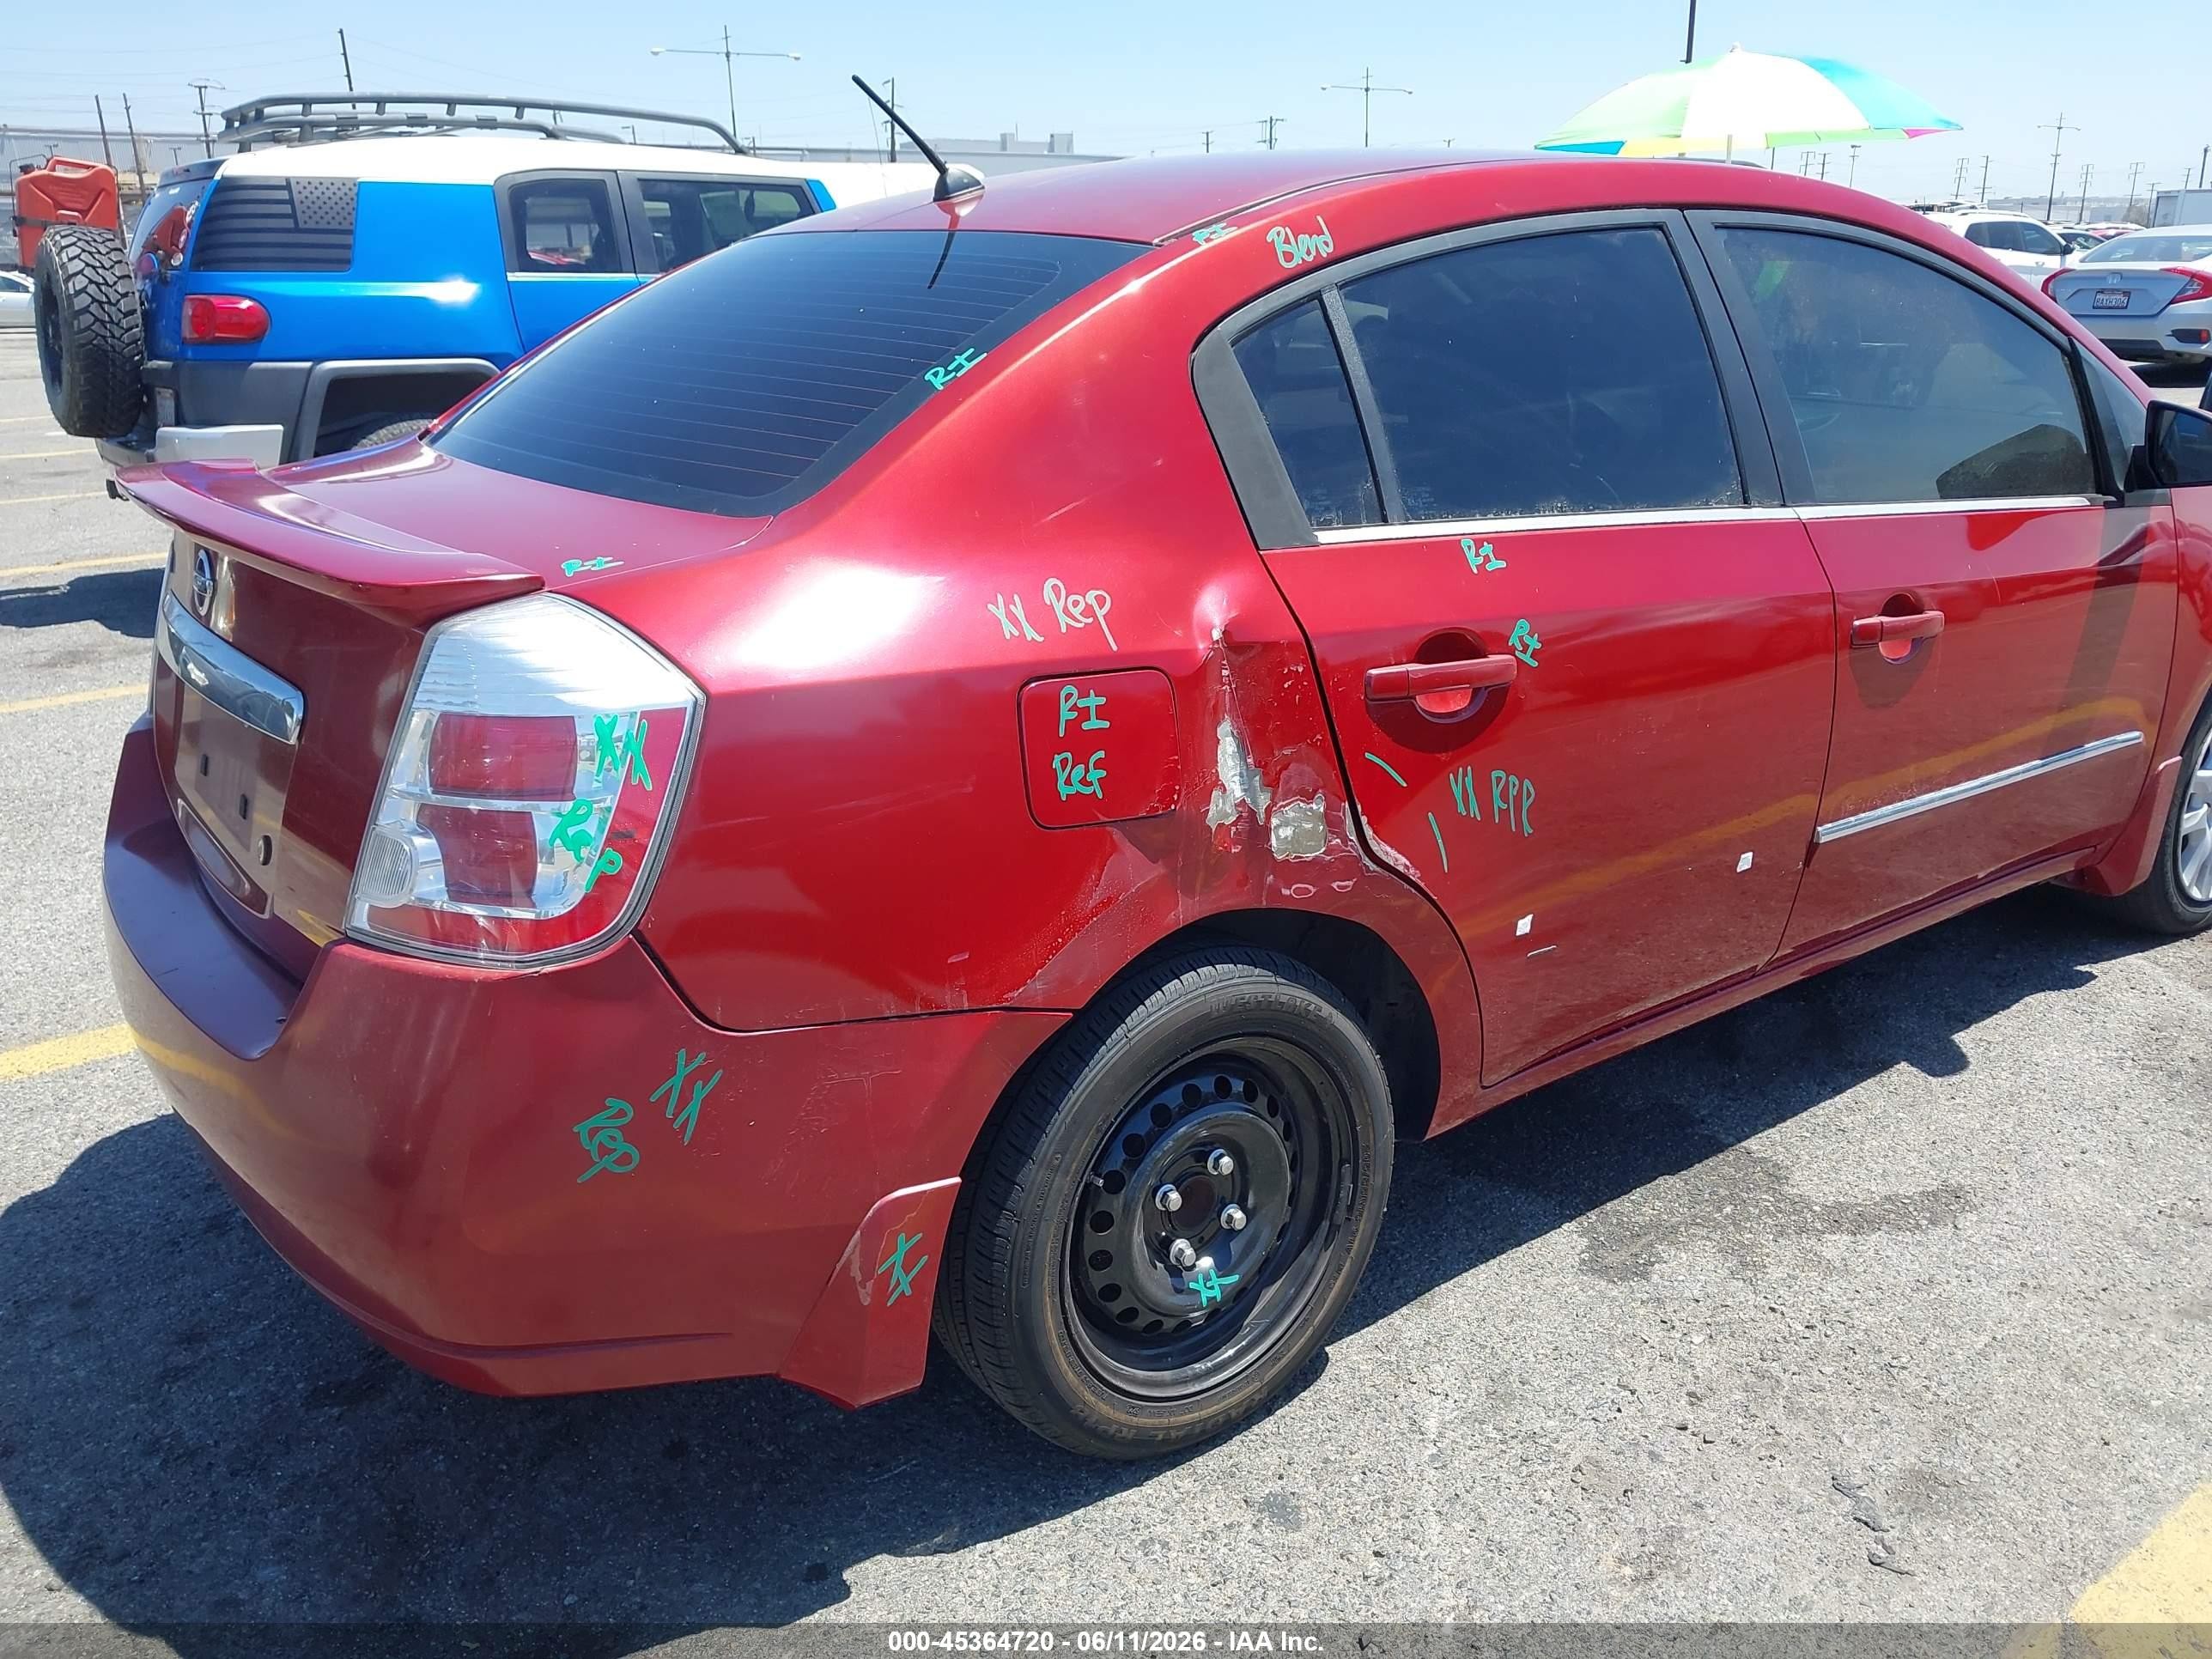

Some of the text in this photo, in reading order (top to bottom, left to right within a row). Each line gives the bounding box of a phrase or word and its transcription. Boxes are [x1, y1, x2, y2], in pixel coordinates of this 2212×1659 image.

[1267, 216, 1334, 268] Blend
[1043, 576, 1118, 653] Rep
[1053, 750, 1107, 800] Ref
